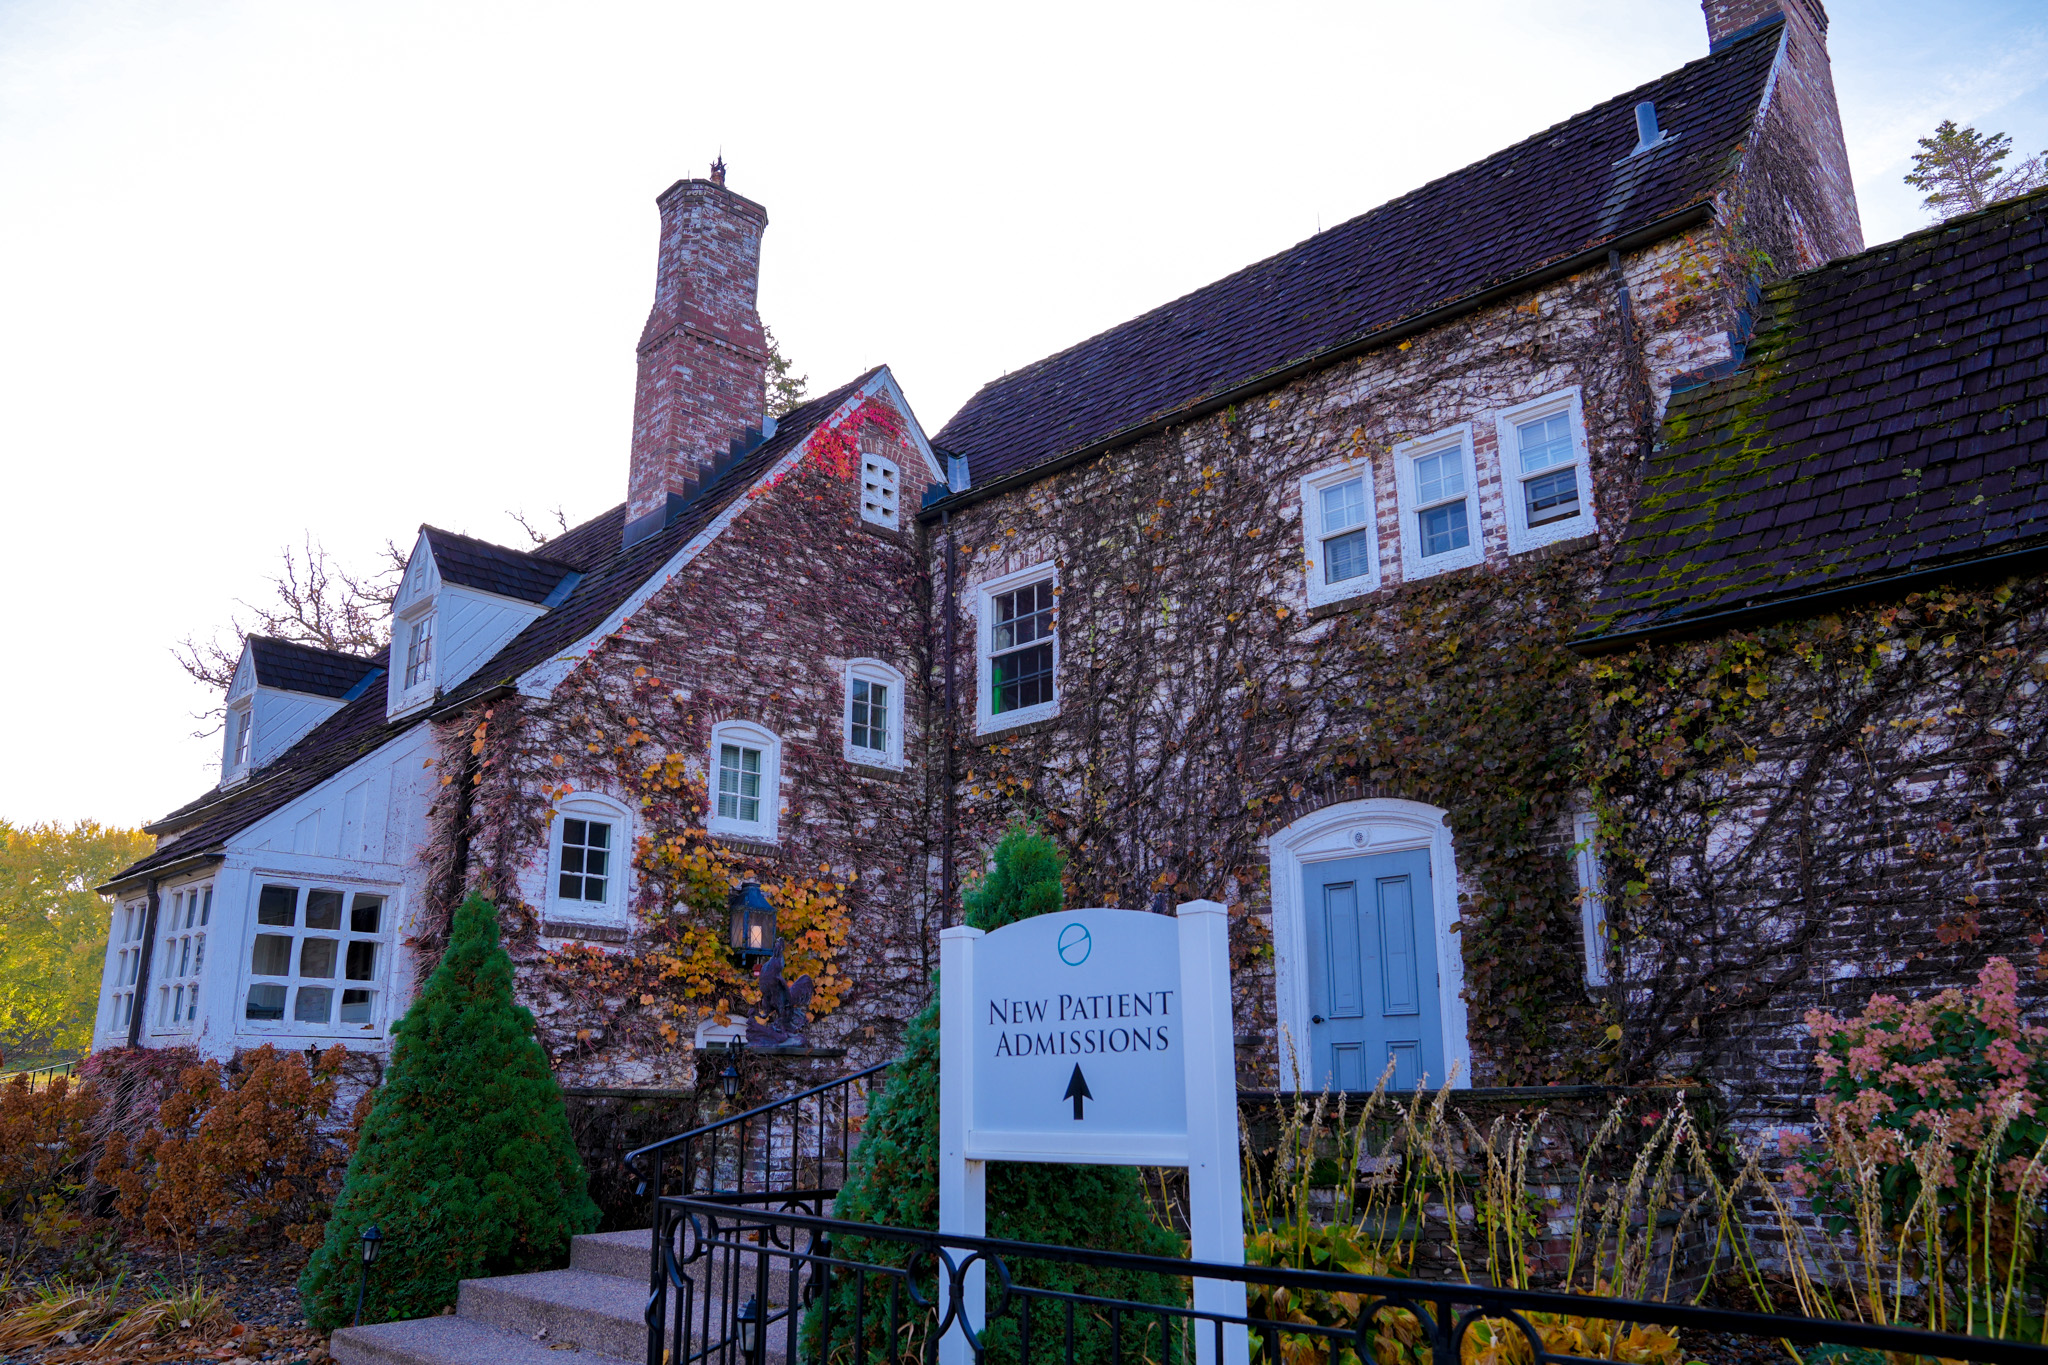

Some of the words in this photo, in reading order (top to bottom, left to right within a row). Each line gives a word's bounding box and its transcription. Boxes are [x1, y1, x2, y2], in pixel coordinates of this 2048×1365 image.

[988, 998, 1048, 1026] NEW
[1058, 990, 1174, 1021] PATIENT
[995, 1025, 1169, 1057] ADMISSIONS
